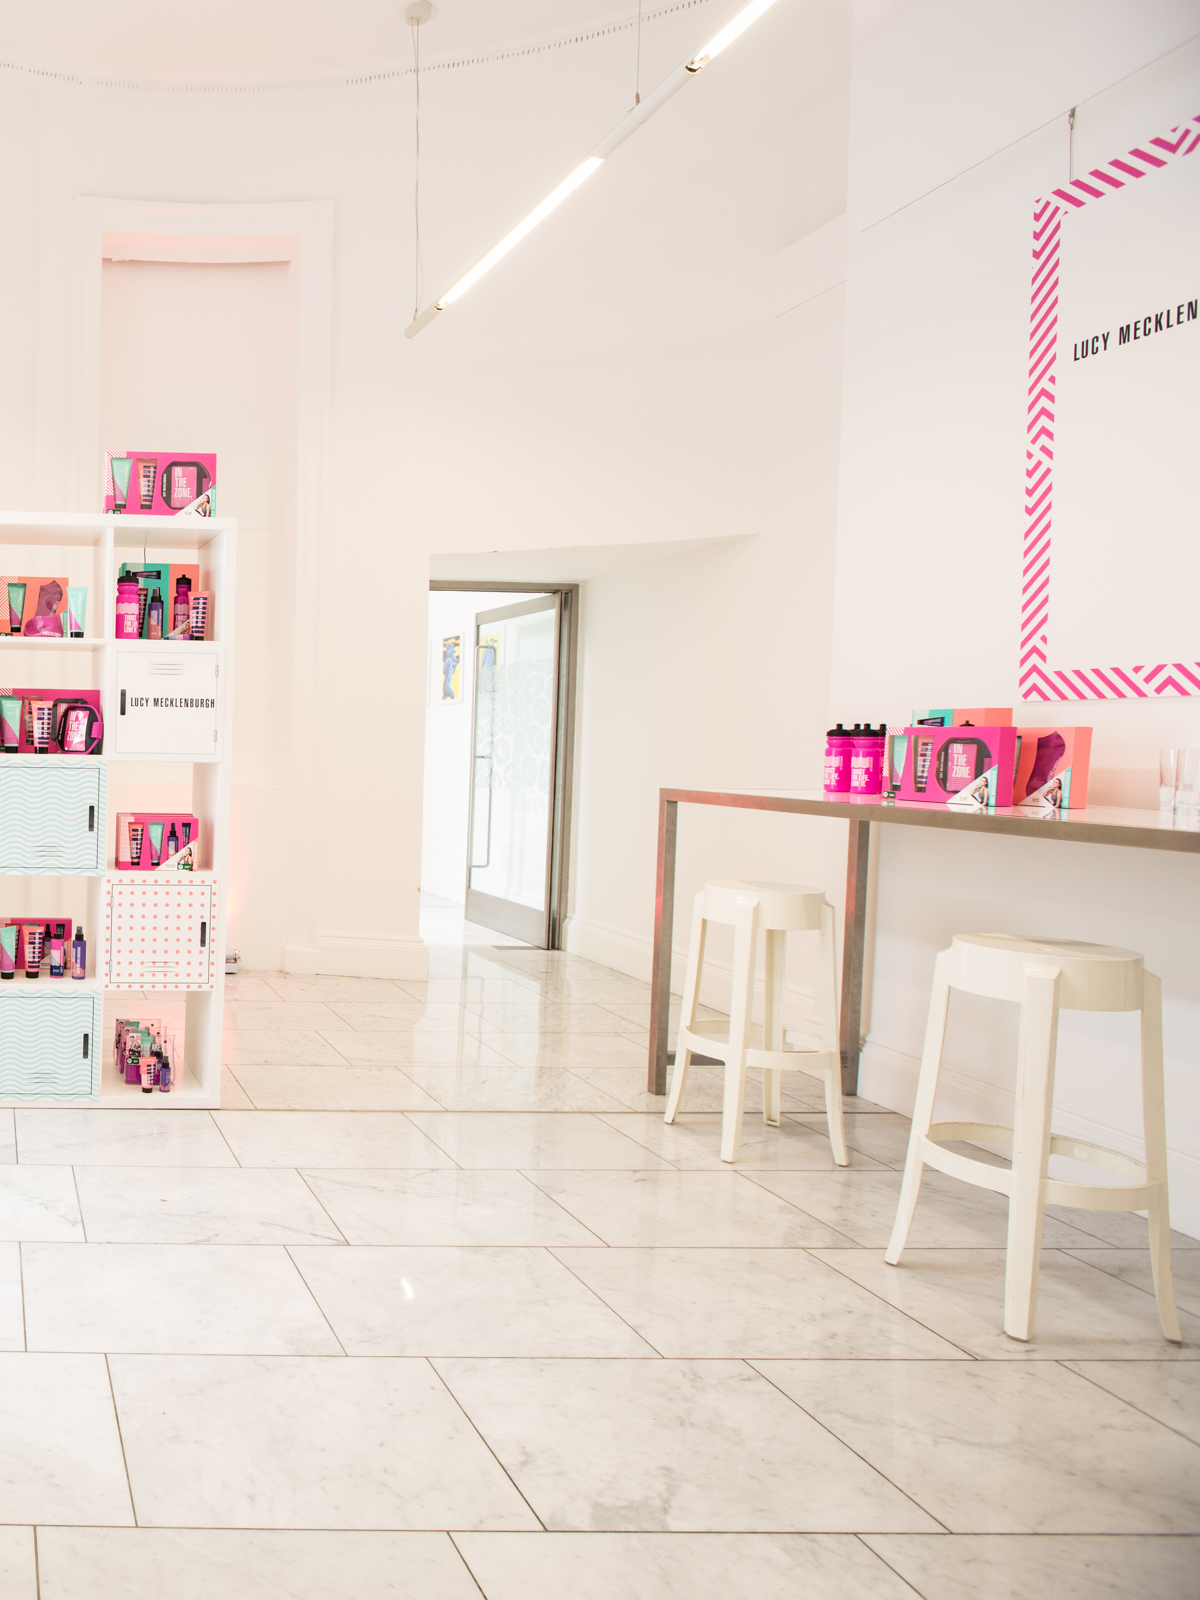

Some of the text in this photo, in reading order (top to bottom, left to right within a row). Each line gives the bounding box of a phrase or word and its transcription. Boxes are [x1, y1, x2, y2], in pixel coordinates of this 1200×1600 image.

[1073, 299, 1199, 362] LUCY MECKLEN
[174, 467, 182, 477] IN
[175, 478, 187, 488] THE
[174, 488, 192, 498] ZONE.
[130, 697, 215, 708] LUCY MECKLENBURGH
[953, 744, 963, 754] IN
[953, 754, 967, 766] THE
[952, 766, 971, 778] ZONE.
